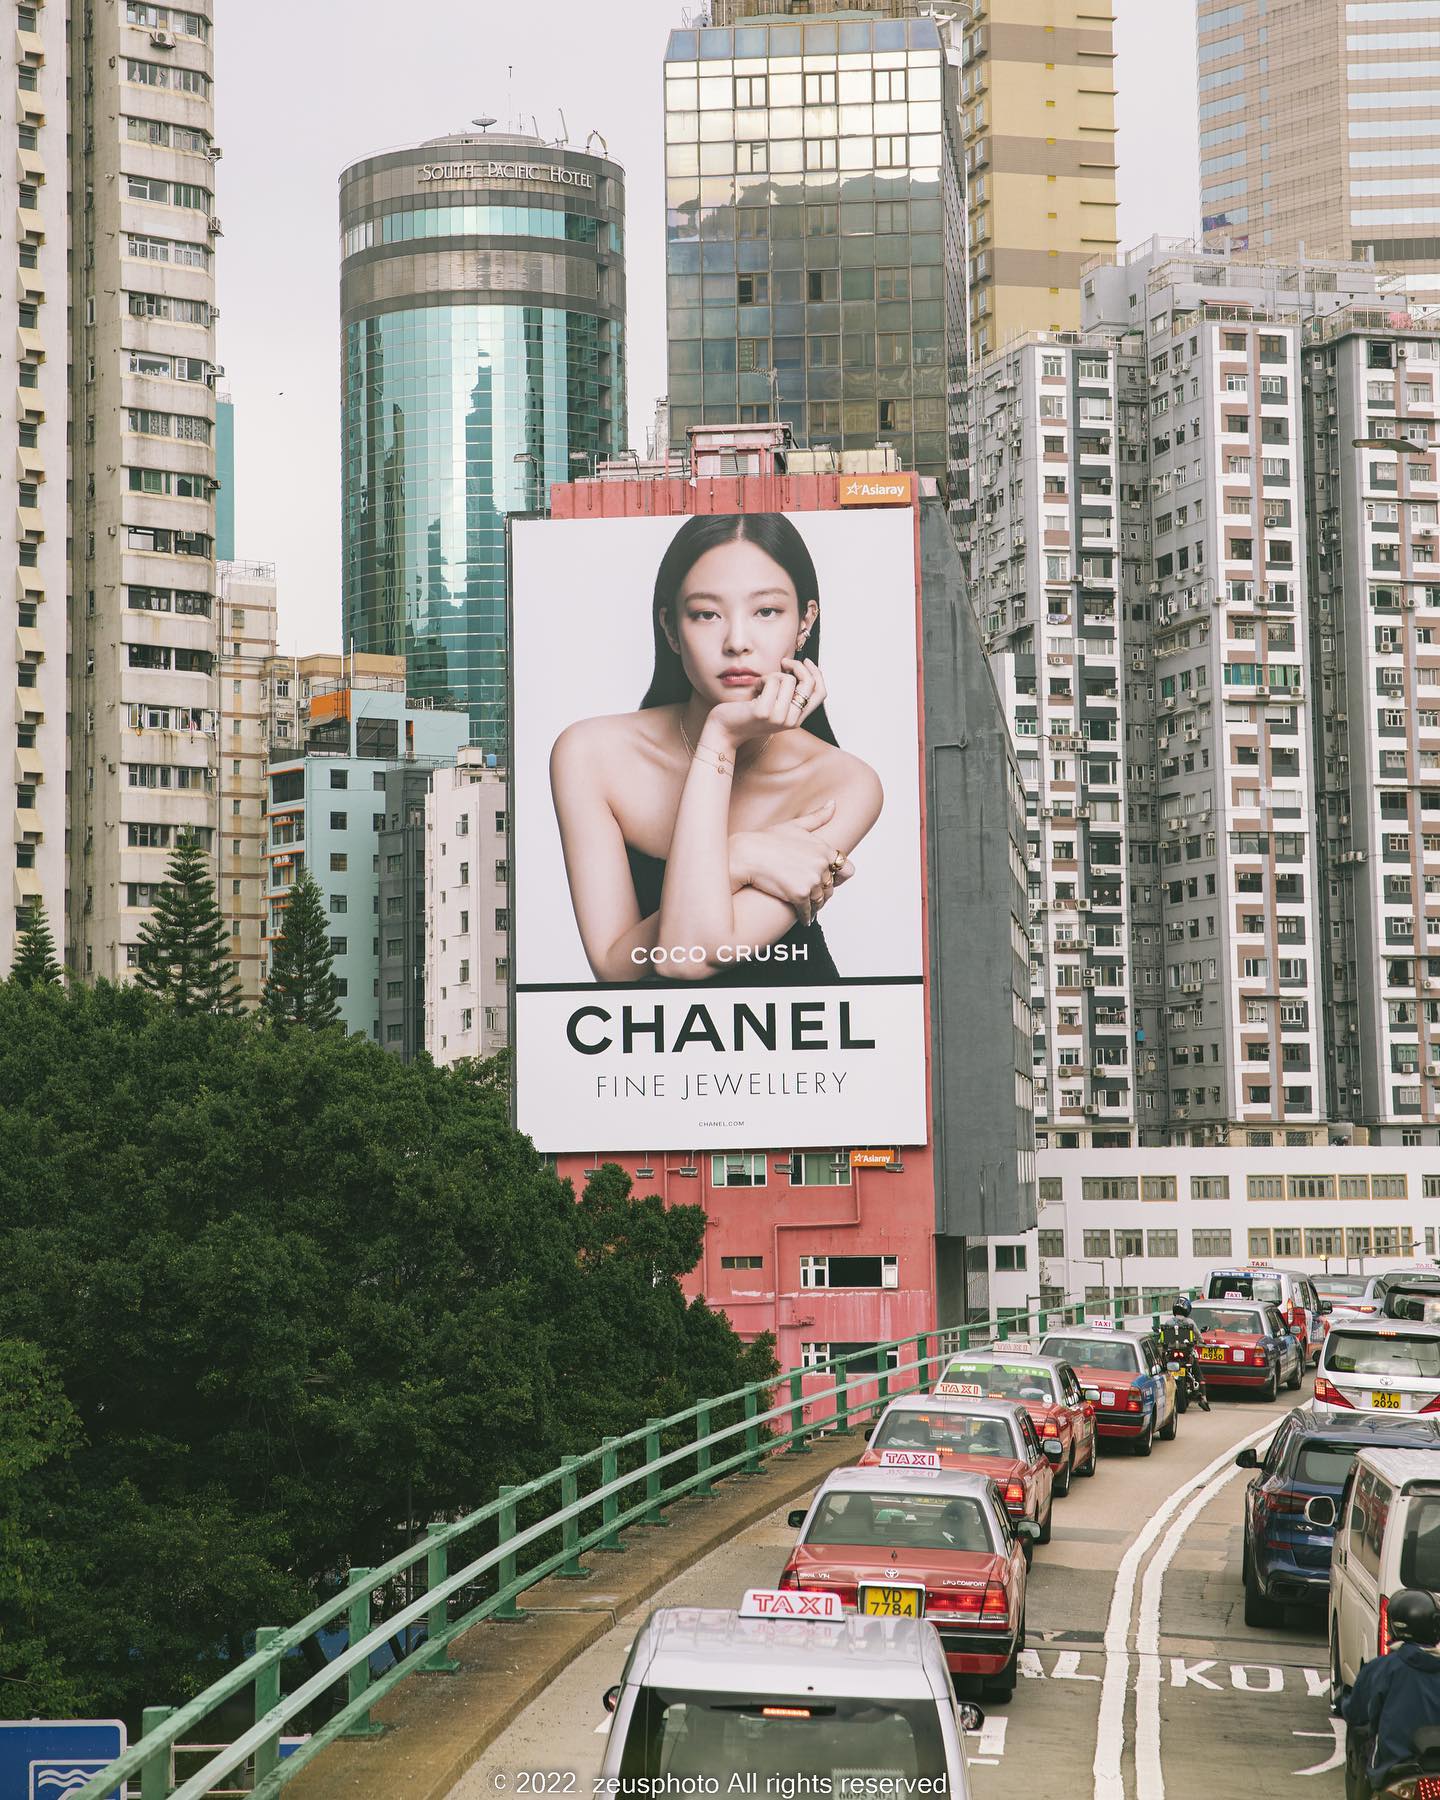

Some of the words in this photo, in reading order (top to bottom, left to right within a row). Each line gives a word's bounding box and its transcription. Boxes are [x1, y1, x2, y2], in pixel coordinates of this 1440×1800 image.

[424, 164, 474, 181] SOUTH
[488, 162, 540, 180] PACIFIC
[550, 165, 592, 188] HOTEL
[861, 484, 904, 496] Asiaray
[630, 946, 707, 965] COCO
[716, 944, 808, 963] CRUSH
[566, 1001, 876, 1055] CHANEL
[596, 1075, 665, 1098] FINE
[680, 1071, 848, 1100] JEWELLERY
[863, 1155, 891, 1163] Asiaray
[996, 1343, 1028, 1351] TAXI
[940, 1384, 979, 1395] TAXI
[1380, 1393, 1393, 1401] AT
[1374, 1400, 1399, 1409] 2020
[885, 1453, 935, 1466] TAXI
[881, 1588, 902, 1603] VD
[752, 1594, 833, 1616] TAXI
[870, 1603, 912, 1617] 7784
